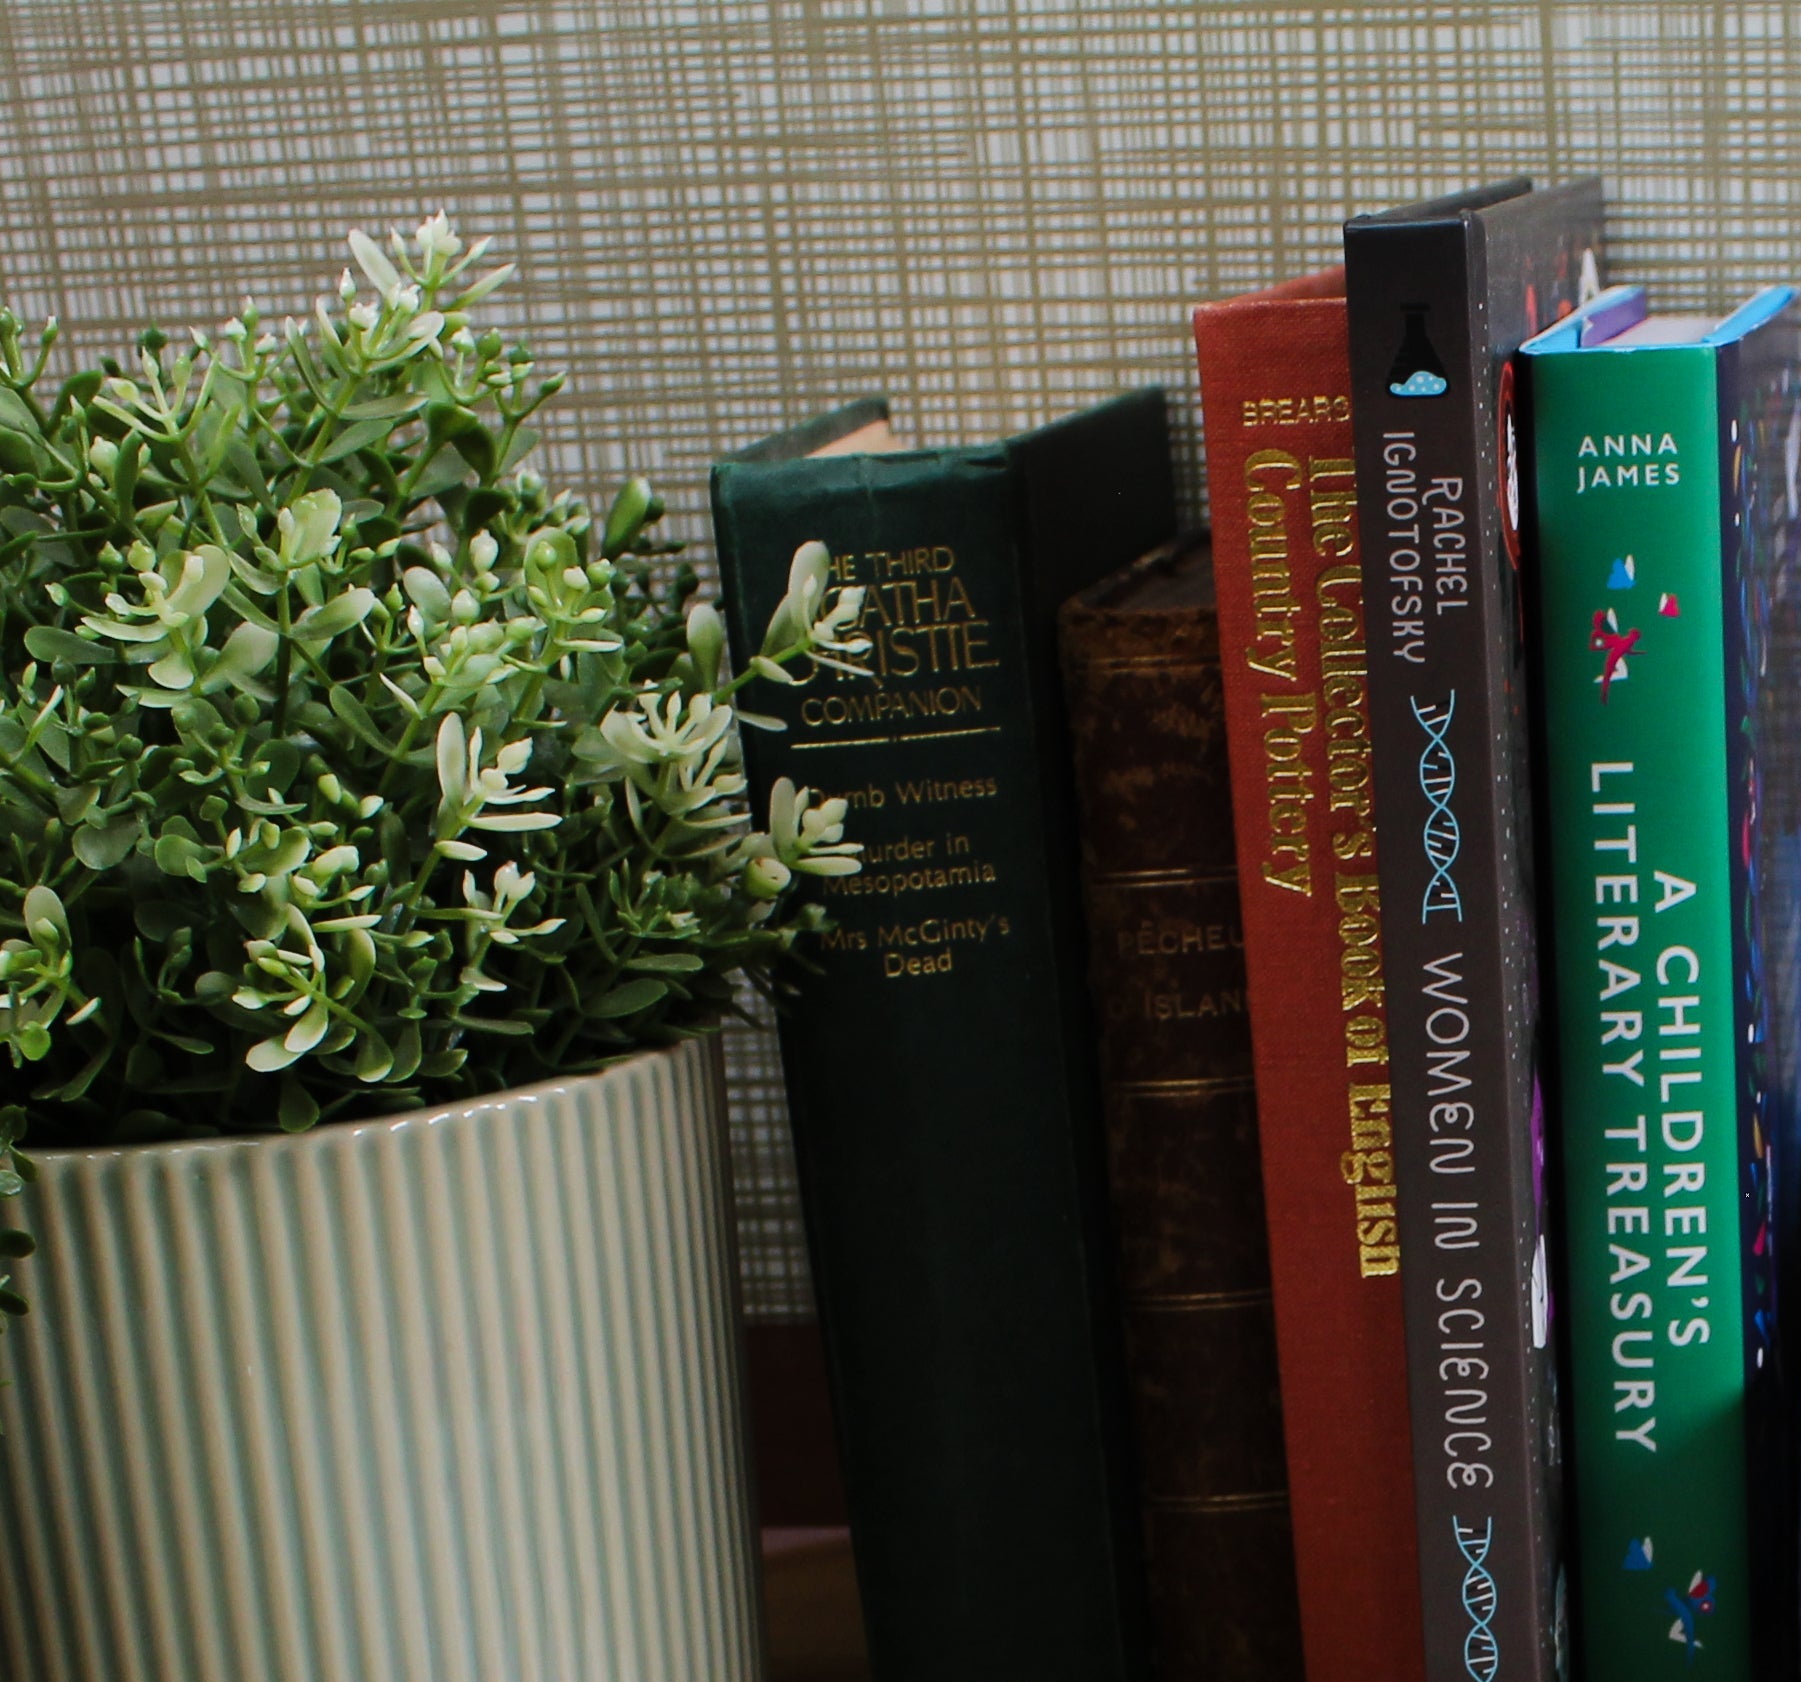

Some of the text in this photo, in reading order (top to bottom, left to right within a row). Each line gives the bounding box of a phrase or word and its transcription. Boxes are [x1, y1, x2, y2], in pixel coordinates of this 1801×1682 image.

[1243, 396, 1350, 426] BREARS
[1578, 433, 1679, 458] ANNA
[1576, 463, 1680, 494] JAMES
[865, 546, 955, 577] THIRD
[1383, 431, 1426, 664] IGNOTOFSKY
[1423, 477, 1468, 616] RACHEL
[1244, 448, 1316, 898] Country Pottery
[801, 687, 983, 728] COMPANION
[896, 777, 999, 806] Witness
[859, 832, 970, 864] urder in
[824, 860, 996, 898] Mesopotamia
[821, 914, 1010, 952] Mrs McGinty's
[884, 948, 952, 979] Dead
[1591, 762, 1657, 1453] LITERARY TREASURY
[1654, 870, 1710, 1347] A CHILDREN'S
[1422, 952, 1494, 1489] WOMEN IN SCIENCE
